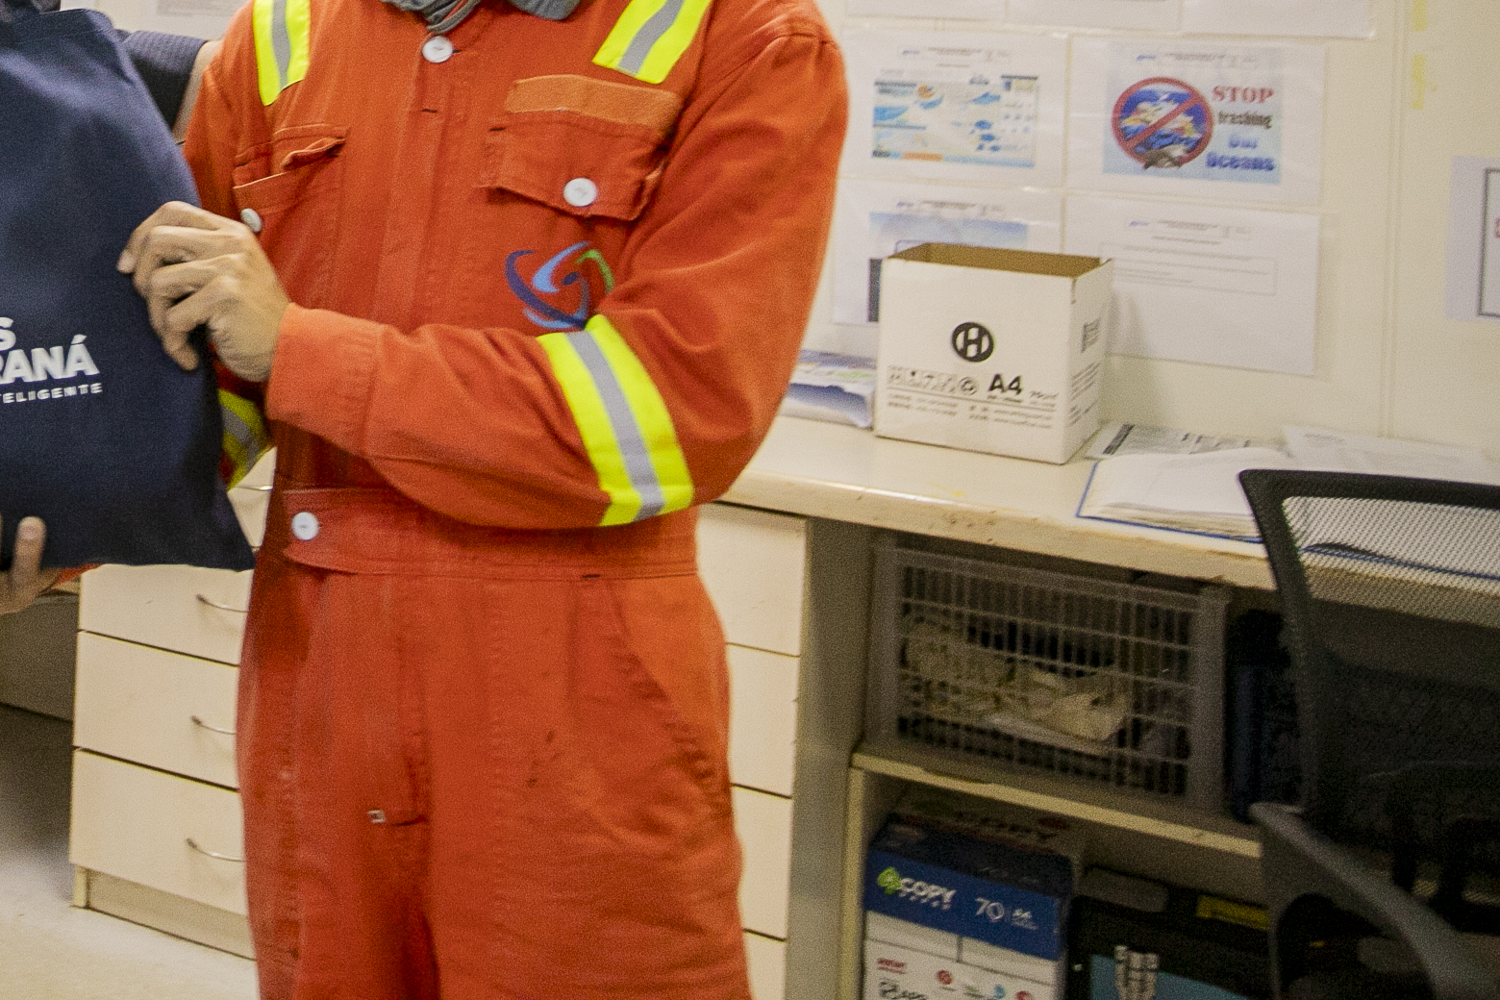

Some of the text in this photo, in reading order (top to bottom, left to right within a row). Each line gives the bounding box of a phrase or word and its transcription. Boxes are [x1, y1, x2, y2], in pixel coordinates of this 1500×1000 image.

[1212, 84, 1275, 104] STOP
[988, 373, 1025, 396] A4
[974, 896, 1006, 923] 70
